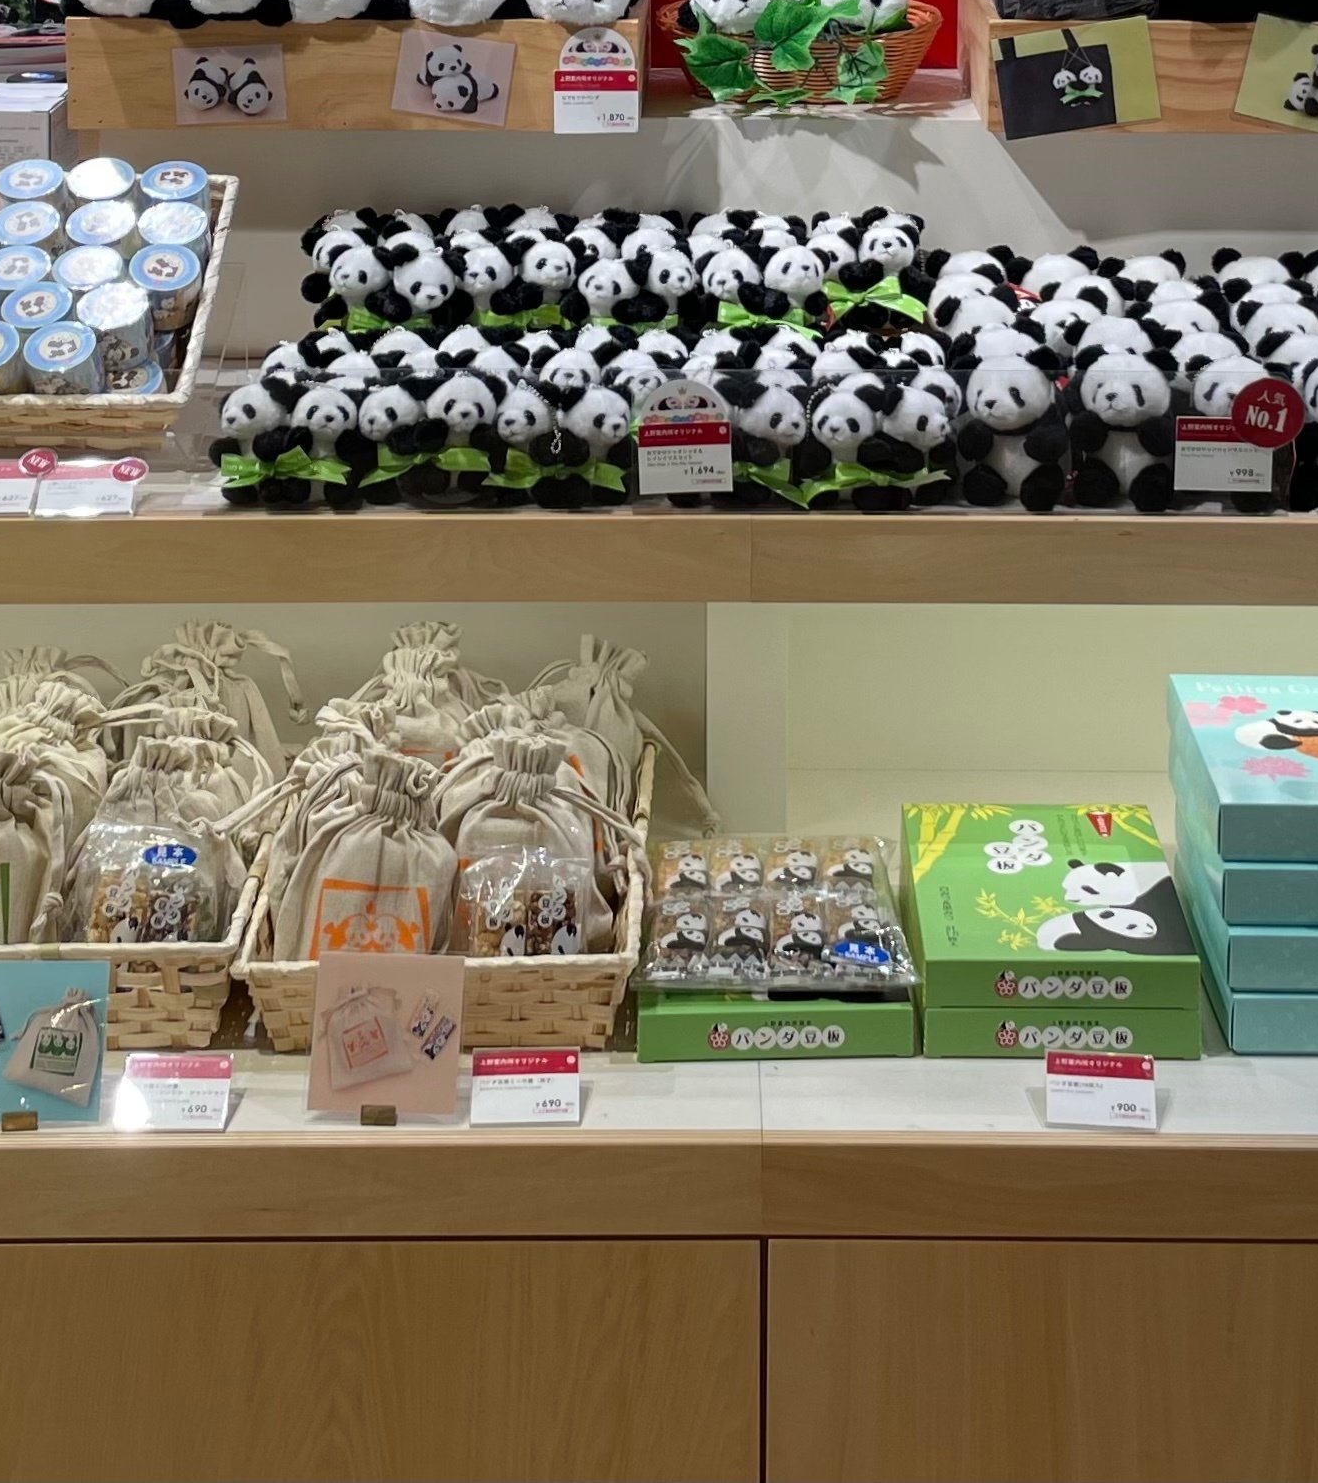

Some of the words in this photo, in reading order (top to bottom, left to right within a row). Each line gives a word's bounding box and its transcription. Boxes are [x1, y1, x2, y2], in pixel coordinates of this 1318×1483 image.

[1257, 390, 1286, 407] 人気
[27, 455, 51, 469] NEW
[118, 464, 141, 477] NEW
[684, 466, 714, 476] ¥1,694
[1230, 468, 1254, 477] ¥998
[849, 944, 876, 956] 見本
[844, 951, 880, 964] SAMPLE
[1022, 979, 1128, 995] パンダ豆板
[735, 1028, 841, 1045] パンダ豆板
[1024, 1029, 1128, 1045] パンダ豆板
[181, 1104, 208, 1113] ¥690
[536, 1099, 562, 1108] ¥690
[1111, 1102, 1137, 1113] ¥900
